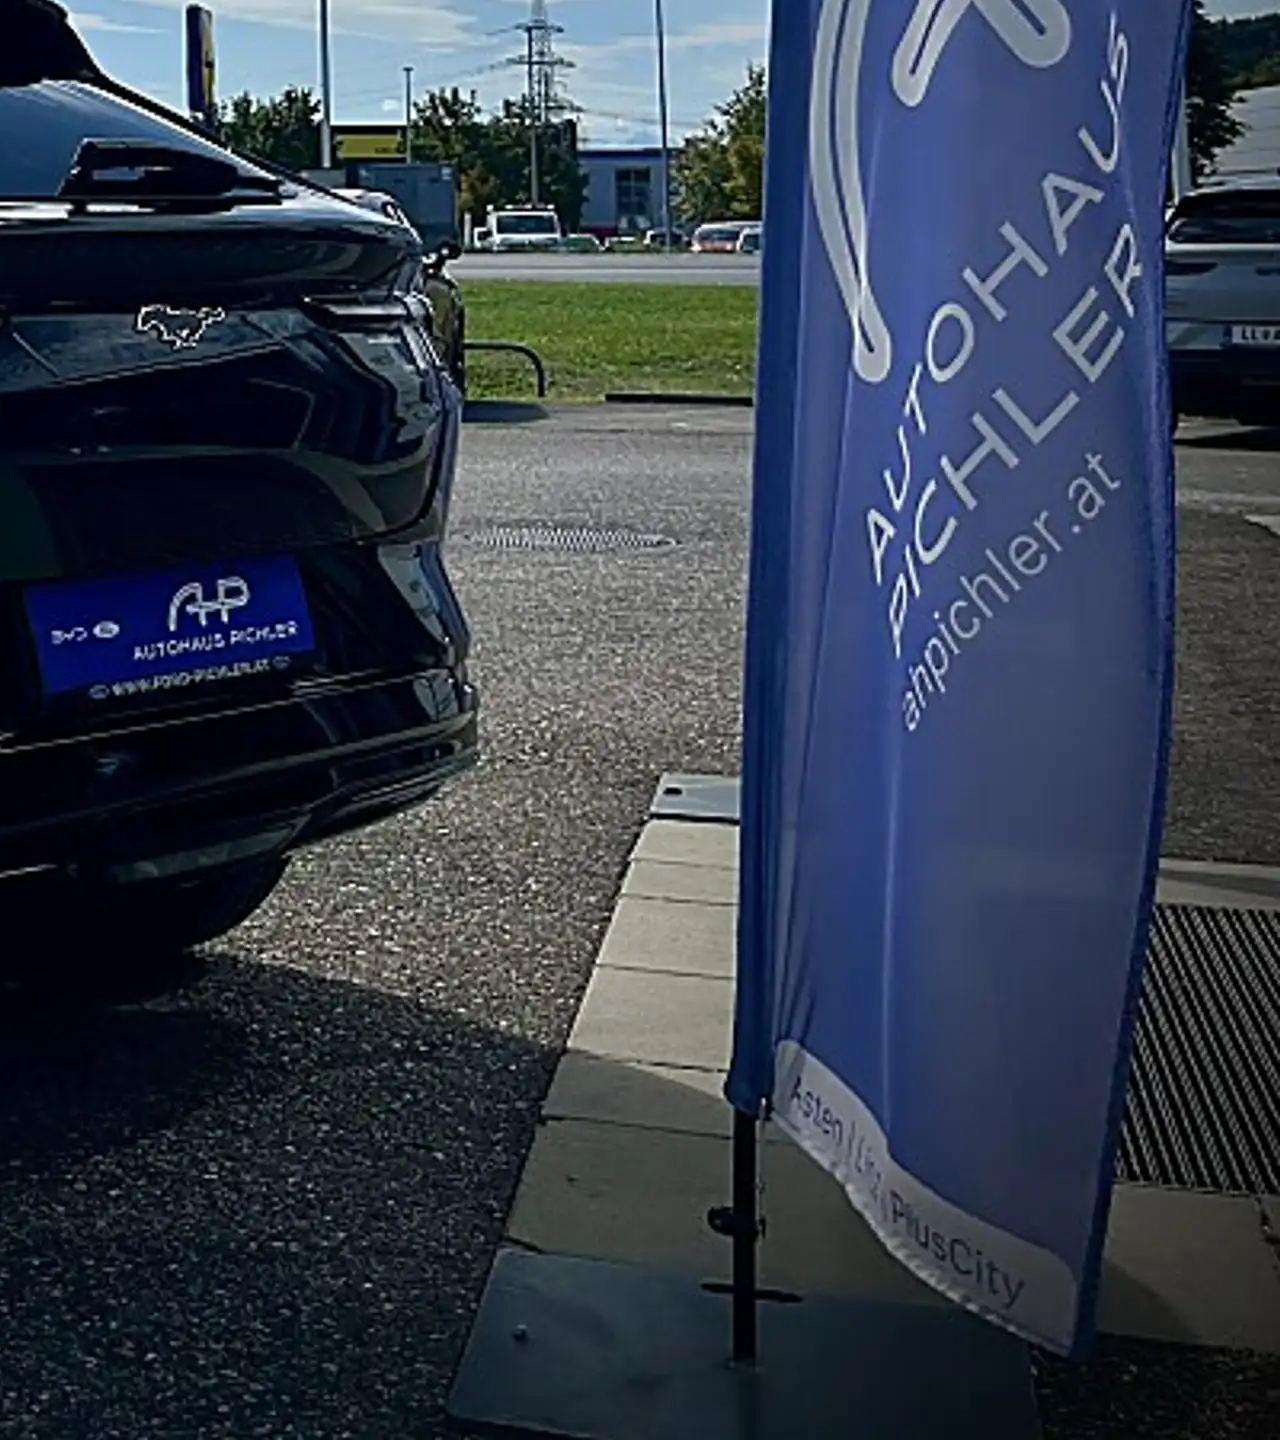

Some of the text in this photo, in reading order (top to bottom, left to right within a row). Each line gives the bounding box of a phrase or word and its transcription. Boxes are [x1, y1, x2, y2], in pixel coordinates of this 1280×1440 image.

[865, 8, 1129, 586] AUTOHAUS
[888, 223, 1142, 659] PICHLER
[132, 632, 227, 661] AUTOHAUS
[901, 451, 1122, 732] ahpichler.at
